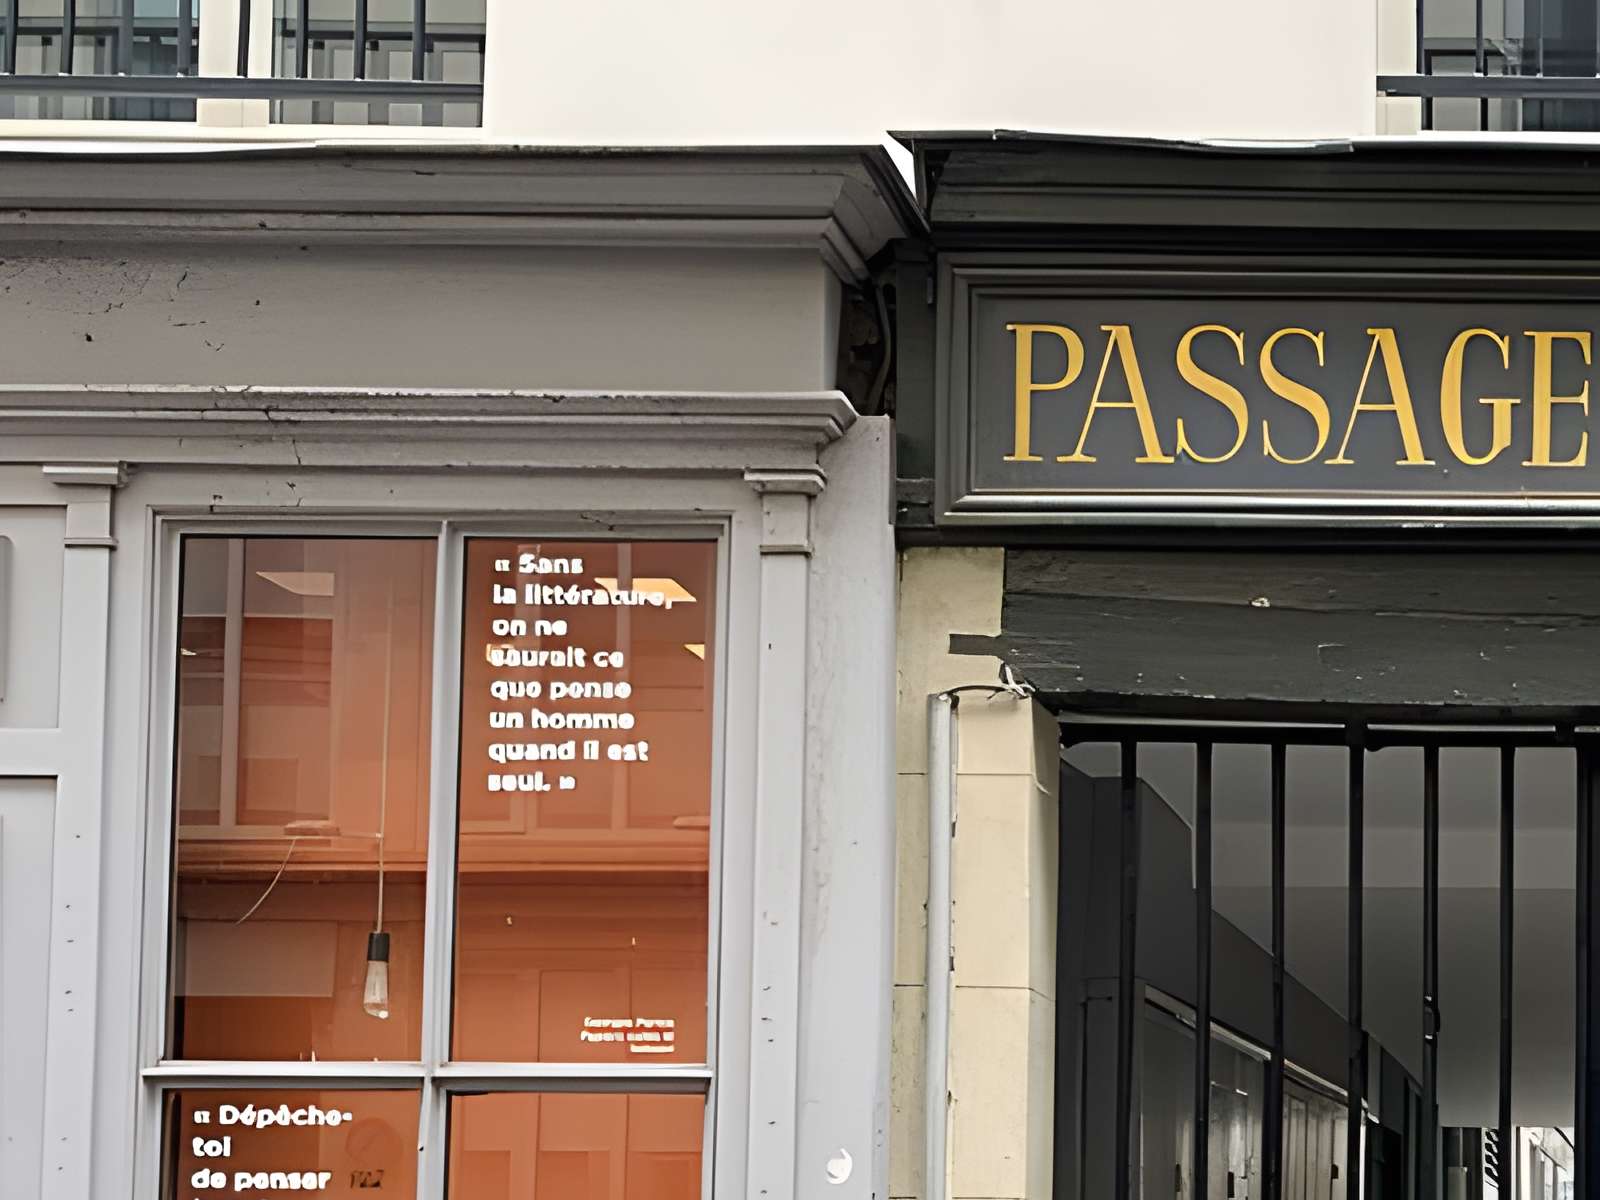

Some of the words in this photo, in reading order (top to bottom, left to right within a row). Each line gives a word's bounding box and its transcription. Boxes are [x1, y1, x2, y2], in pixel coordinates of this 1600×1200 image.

[1004, 322, 1593, 468] PASSAGE
[519, 553, 583, 573] Sans
[493, 584, 517, 604] la
[525, 584, 672, 609] littérature,
[492, 619, 527, 636] on
[535, 620, 567, 636] ne
[490, 680, 542, 701] que
[489, 712, 524, 728] un
[531, 708, 635, 729] homme
[488, 741, 576, 764] quand
[583, 741, 599, 760] il
[607, 741, 649, 761] est
[192, 1136, 231, 1157] toi
[191, 1168, 227, 1189] de
[234, 1171, 332, 1192] penser
